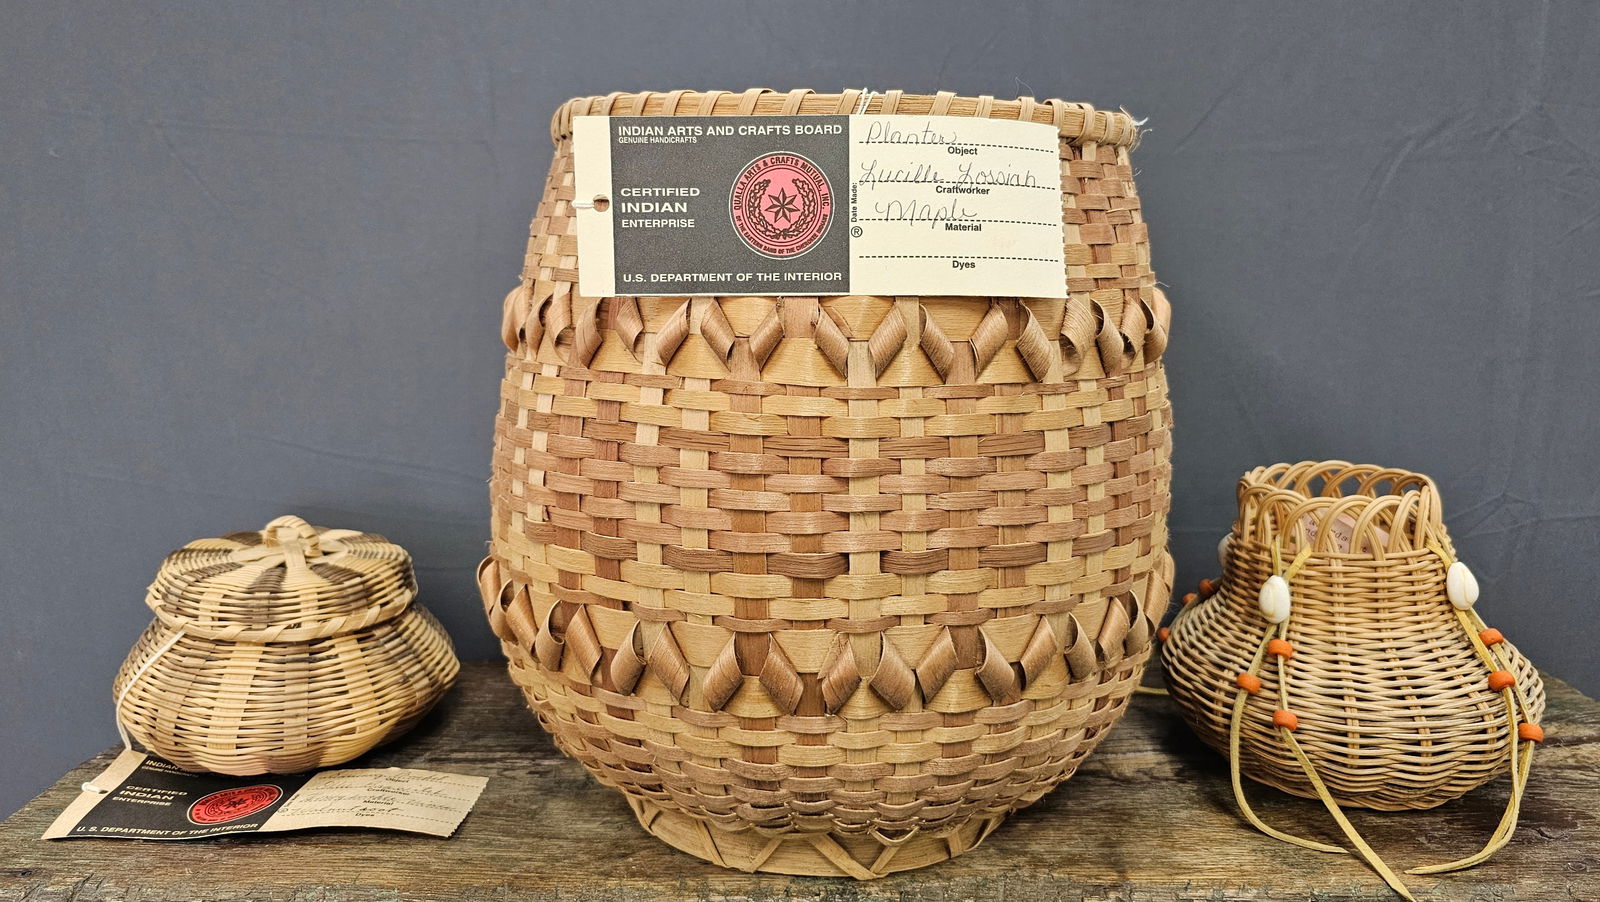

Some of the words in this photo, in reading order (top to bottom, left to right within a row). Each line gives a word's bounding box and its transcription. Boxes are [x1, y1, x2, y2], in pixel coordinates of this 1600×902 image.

[618, 126, 664, 136] INDIAN
[667, 126, 703, 136] ARTS
[706, 126, 735, 136] AND
[738, 125, 791, 136] CRAFTS
[794, 124, 842, 135] BOARD
[618, 136, 649, 144] GENUINE
[650, 136, 698, 144] HANDICRAFTS
[947, 146, 978, 156] Object
[733, 180, 747, 211] QUALLA
[744, 163, 762, 181] ARTS
[770, 156, 799, 166] CRAFTS
[821, 193, 830, 210] INC.
[620, 187, 701, 197] CERTIFIED
[850, 182, 858, 205] Made:
[935, 185, 991, 195] Craftworker
[621, 202, 688, 213] INDIAN
[850, 206, 858, 223] Date
[621, 219, 695, 228] ENTERPRISE
[944, 223, 982, 232] Material
[952, 260, 976, 270] Dyes
[623, 273, 647, 283] U.S.
[650, 273, 733, 282] DEPARTMENT
[736, 273, 753, 282] OF
[756, 273, 780, 281] THE
[784, 272, 842, 281] INTERIOR
[145, 759, 179, 770] INDIAN
[119, 790, 175, 800] INDIAN
[126, 785, 188, 796] CERTIFIED
[112, 796, 172, 806] ENTERPRISE
[100, 826, 171, 835] DEPARTMENT
[209, 823, 259, 833] INTERIOR
